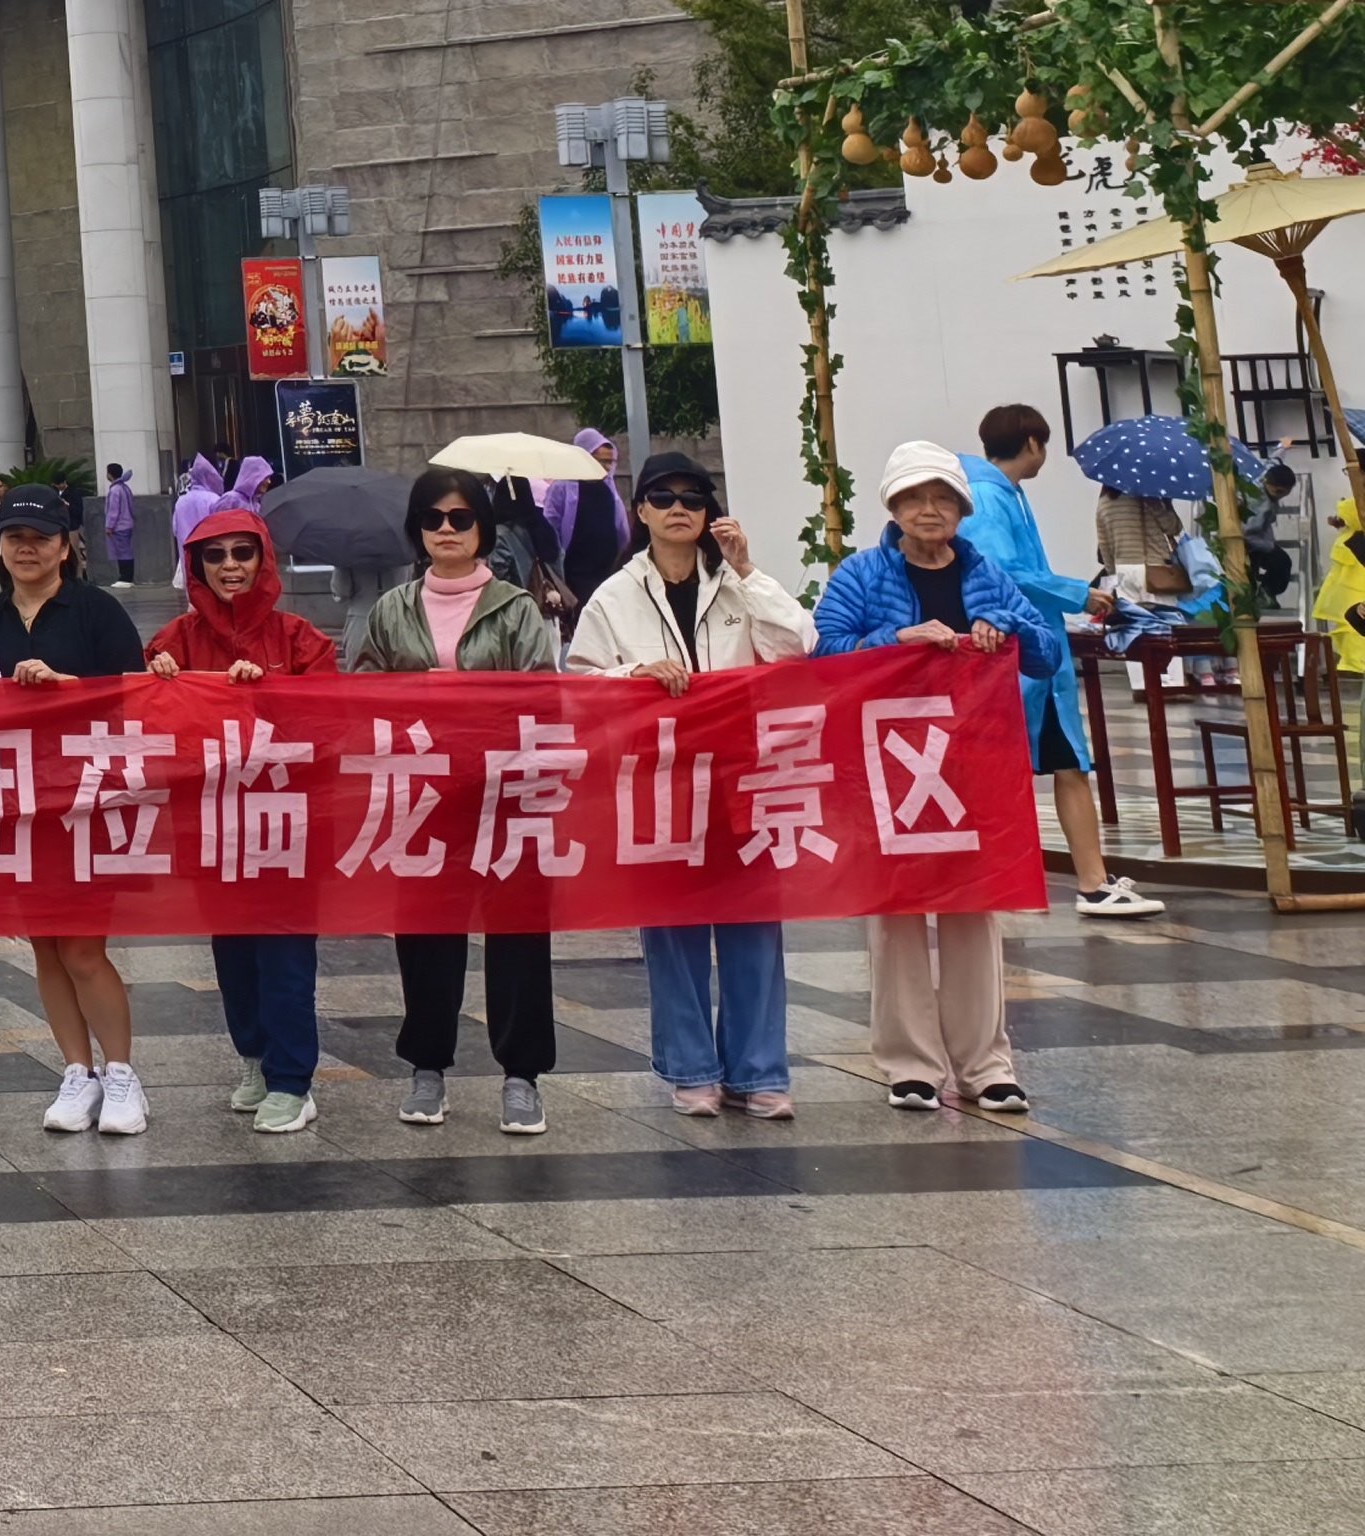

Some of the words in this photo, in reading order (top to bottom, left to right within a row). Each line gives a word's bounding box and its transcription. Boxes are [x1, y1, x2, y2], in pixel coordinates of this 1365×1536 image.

[656, 222, 696, 240] 中国梦
[555, 235, 603, 248] 人民有信仰
[556, 253, 604, 266] 国家有力量
[660, 252, 698, 261] 国家富强
[557, 272, 606, 285] 民族有希望
